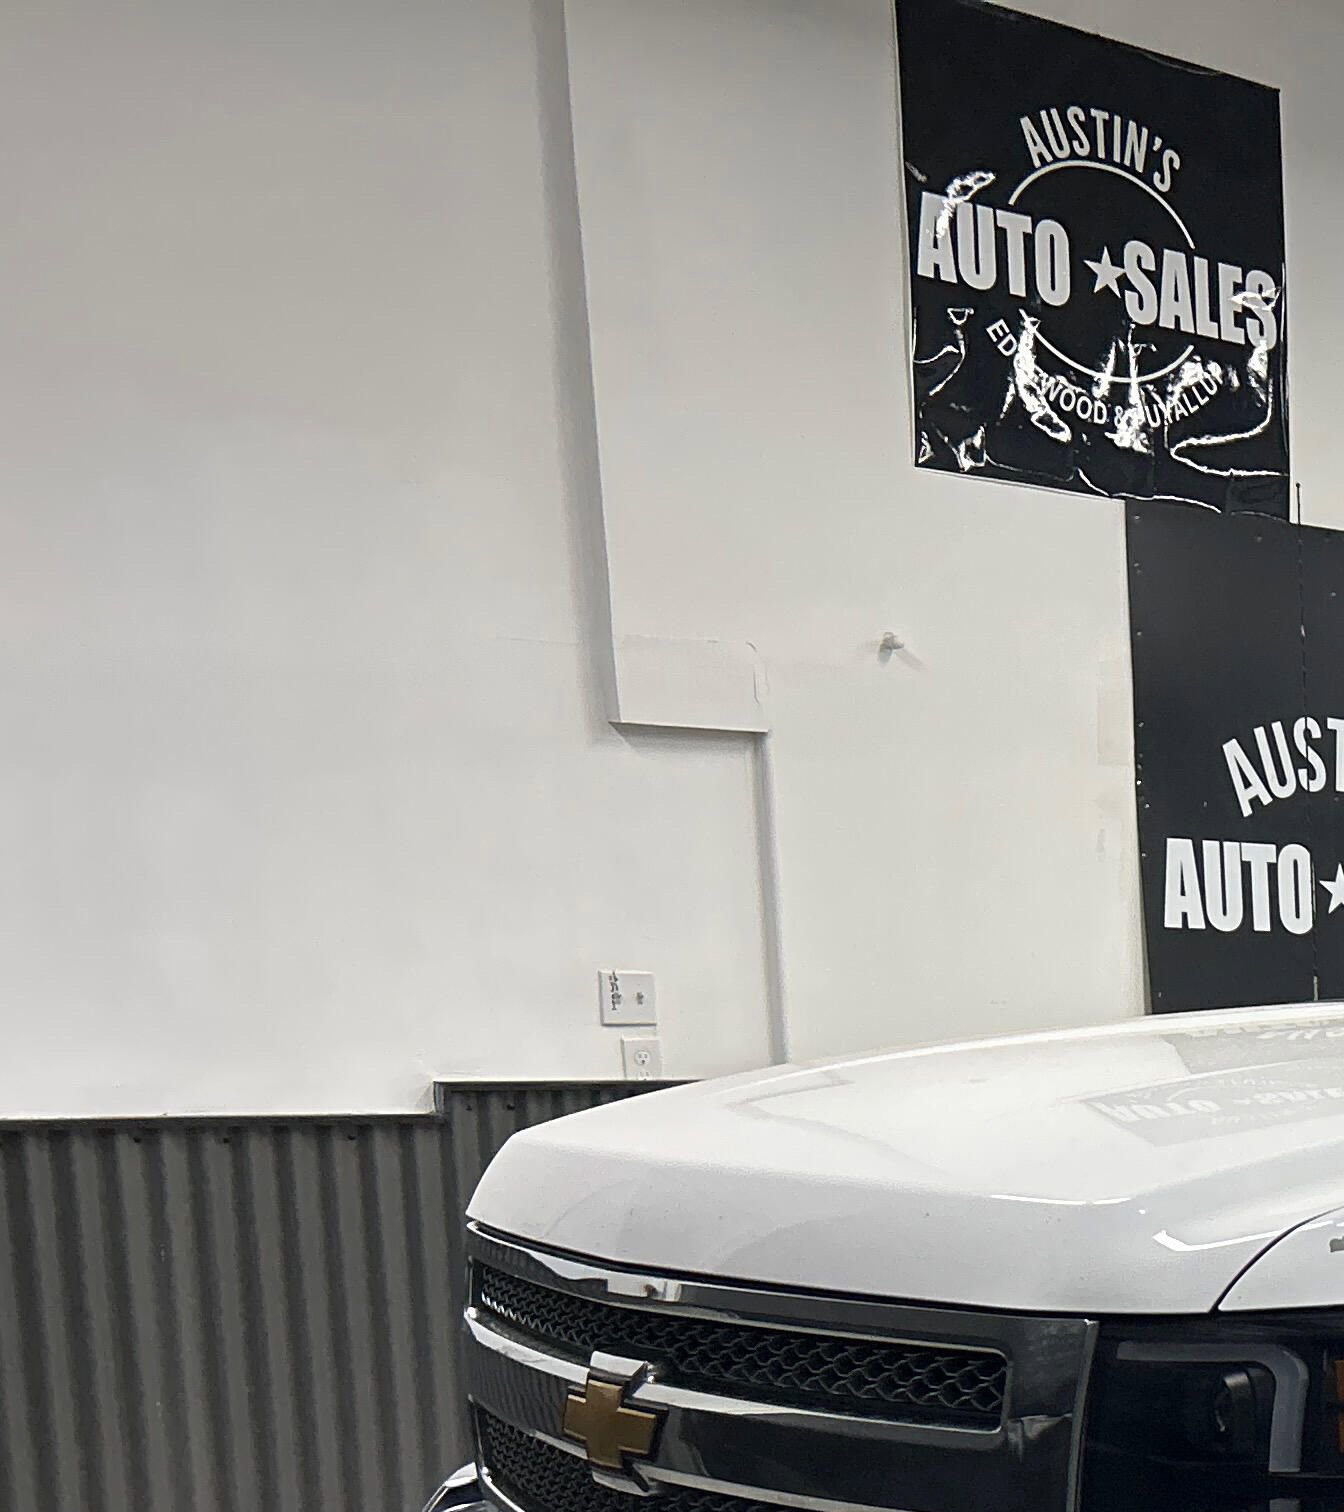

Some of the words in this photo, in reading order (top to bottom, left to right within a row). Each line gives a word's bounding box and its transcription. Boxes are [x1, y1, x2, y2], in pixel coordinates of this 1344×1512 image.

[1019, 105, 1181, 193] AUSTIN'S
[916, 190, 1071, 307] AUTO
[1123, 239, 1278, 351] SALES
[985, 318, 1108, 425] EDWOOD
[1133, 362, 1224, 429] UYALLUP
[1162, 837, 1314, 936] AUTO
